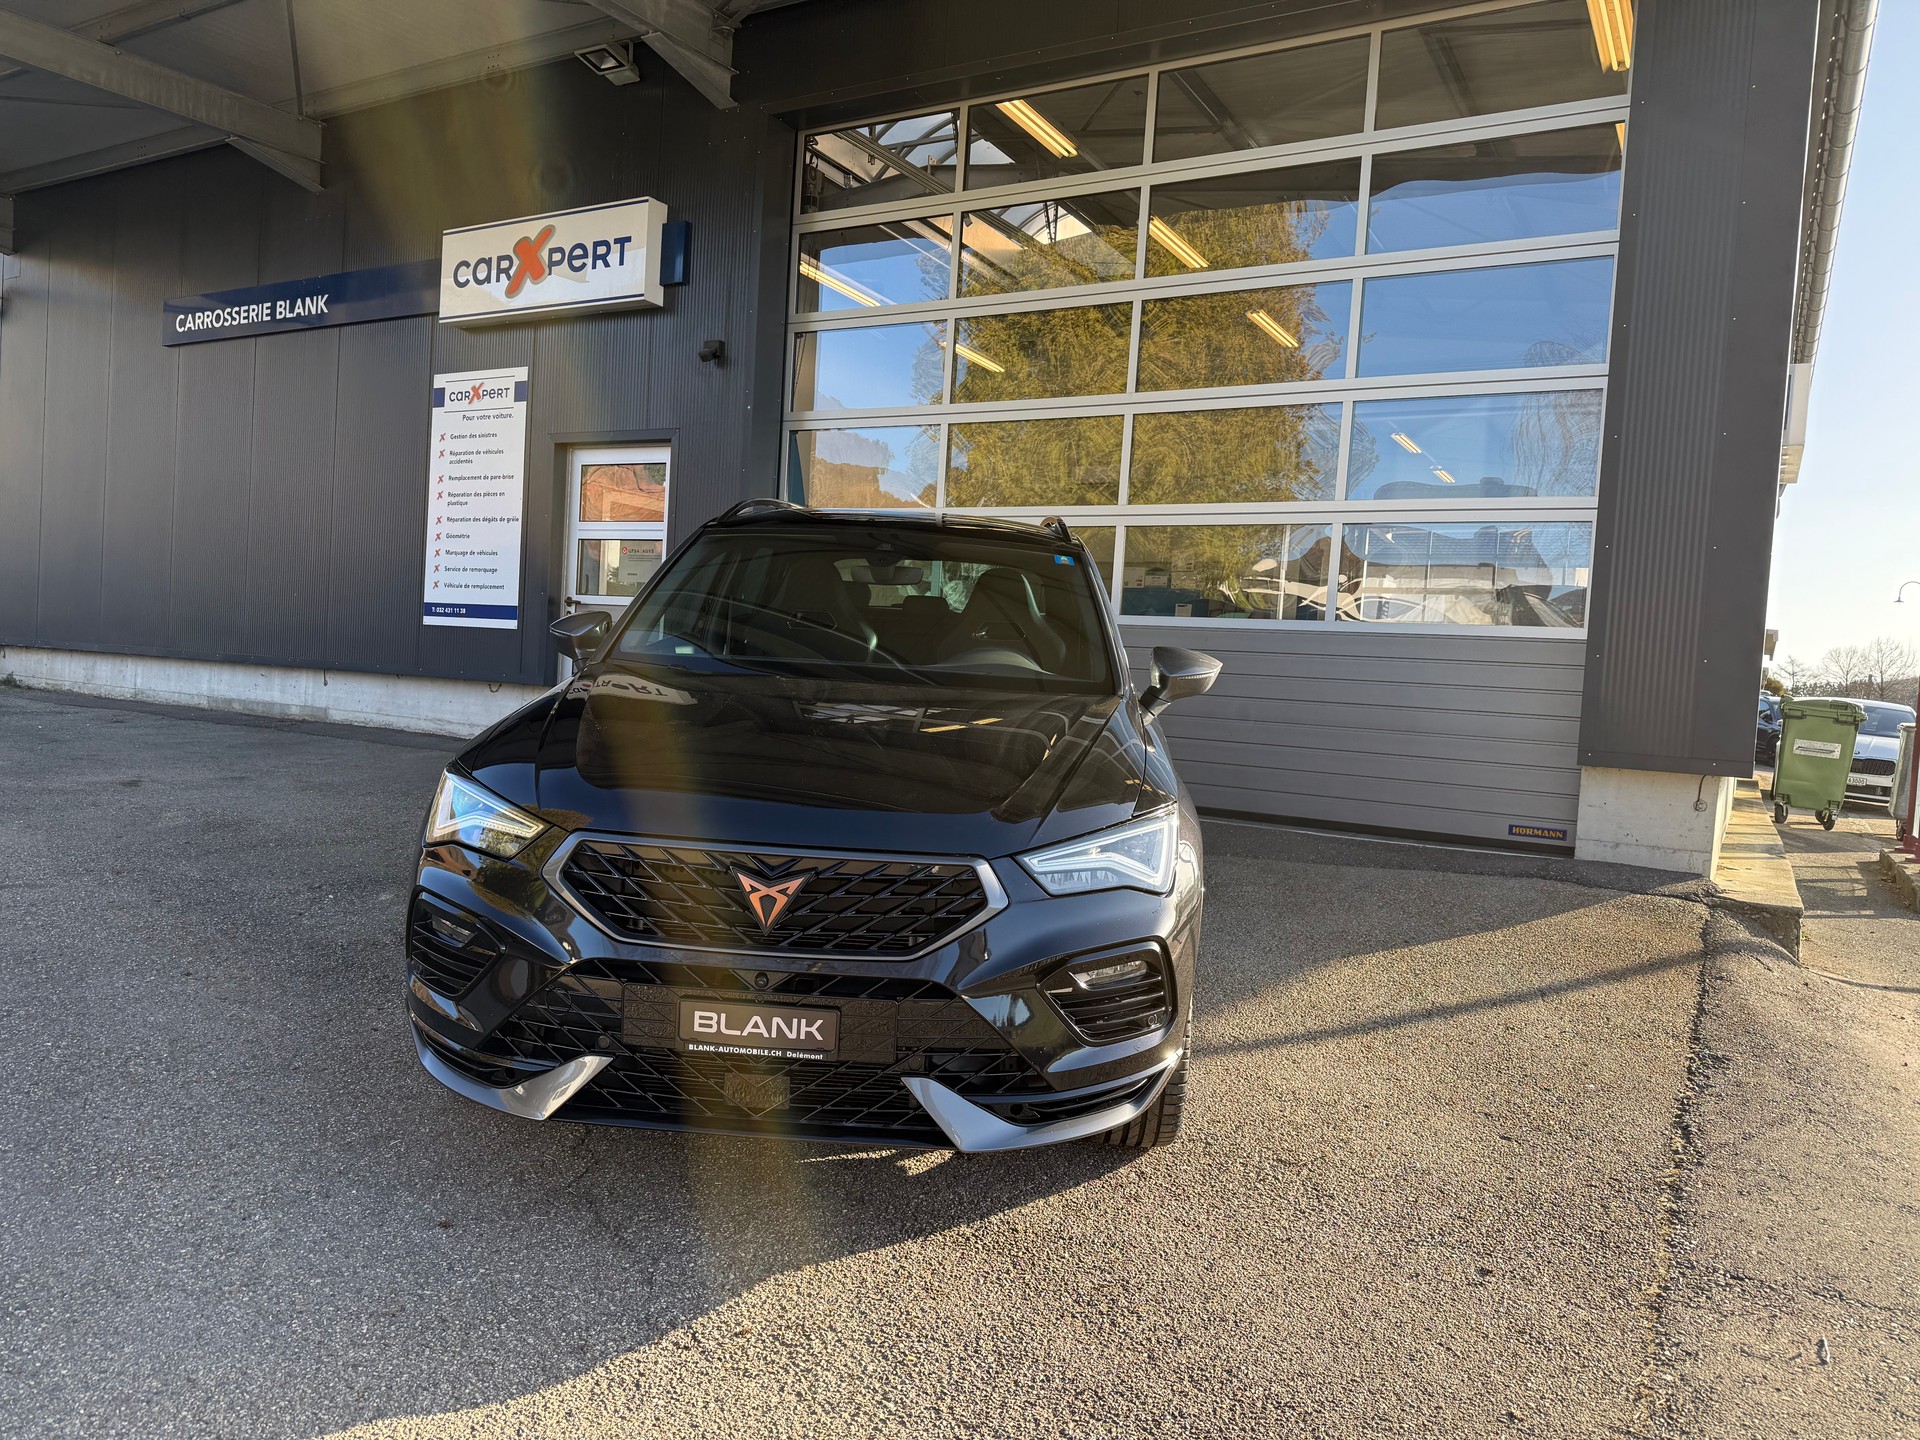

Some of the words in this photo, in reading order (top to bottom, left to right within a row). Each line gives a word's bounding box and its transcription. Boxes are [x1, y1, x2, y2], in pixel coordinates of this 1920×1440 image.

[175, 303, 271, 332] CARROSSERIE
[276, 294, 328, 320] BLANK
[694, 1011, 823, 1040] BLANK
[689, 1044, 782, 1056] BLANK-AUTOMOBILE.CH
